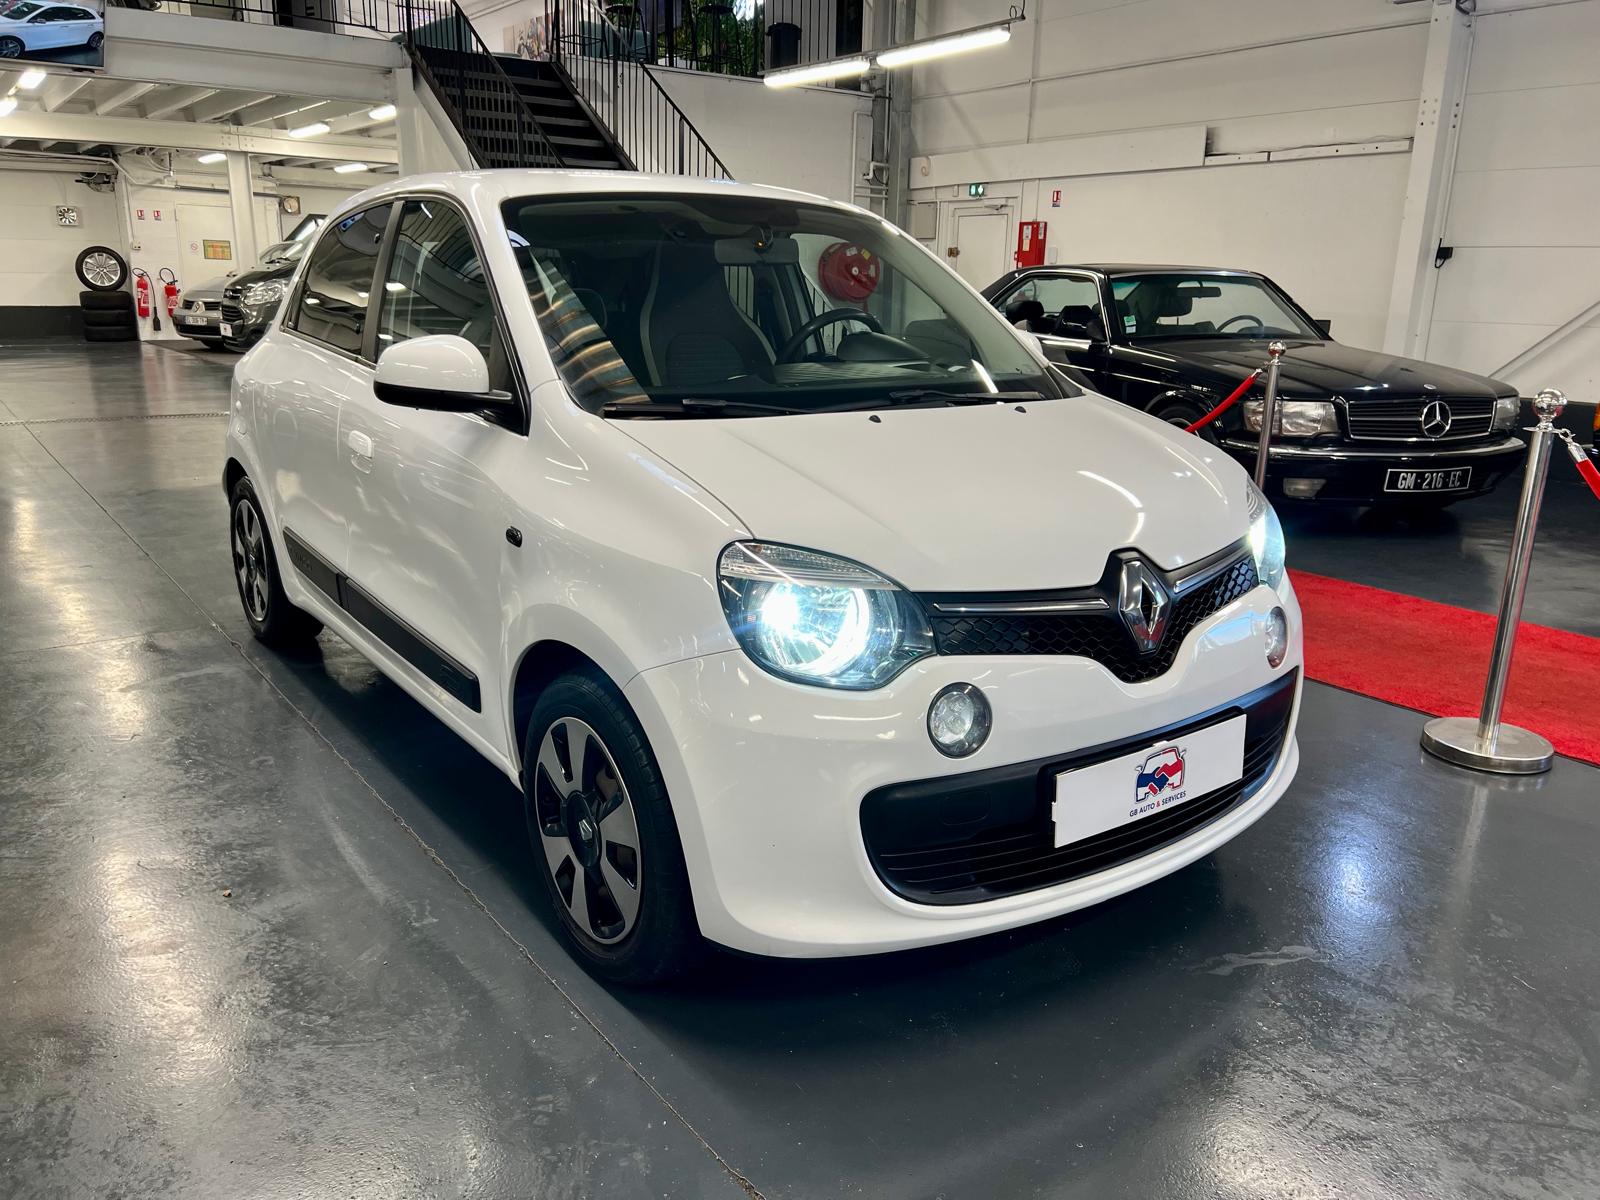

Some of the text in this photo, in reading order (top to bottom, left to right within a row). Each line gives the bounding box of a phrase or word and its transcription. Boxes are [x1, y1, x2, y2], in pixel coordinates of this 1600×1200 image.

[1129, 808, 1138, 817] GB
[1139, 802, 1155, 813] AUTO
[1161, 791, 1186, 805] SERVICES
